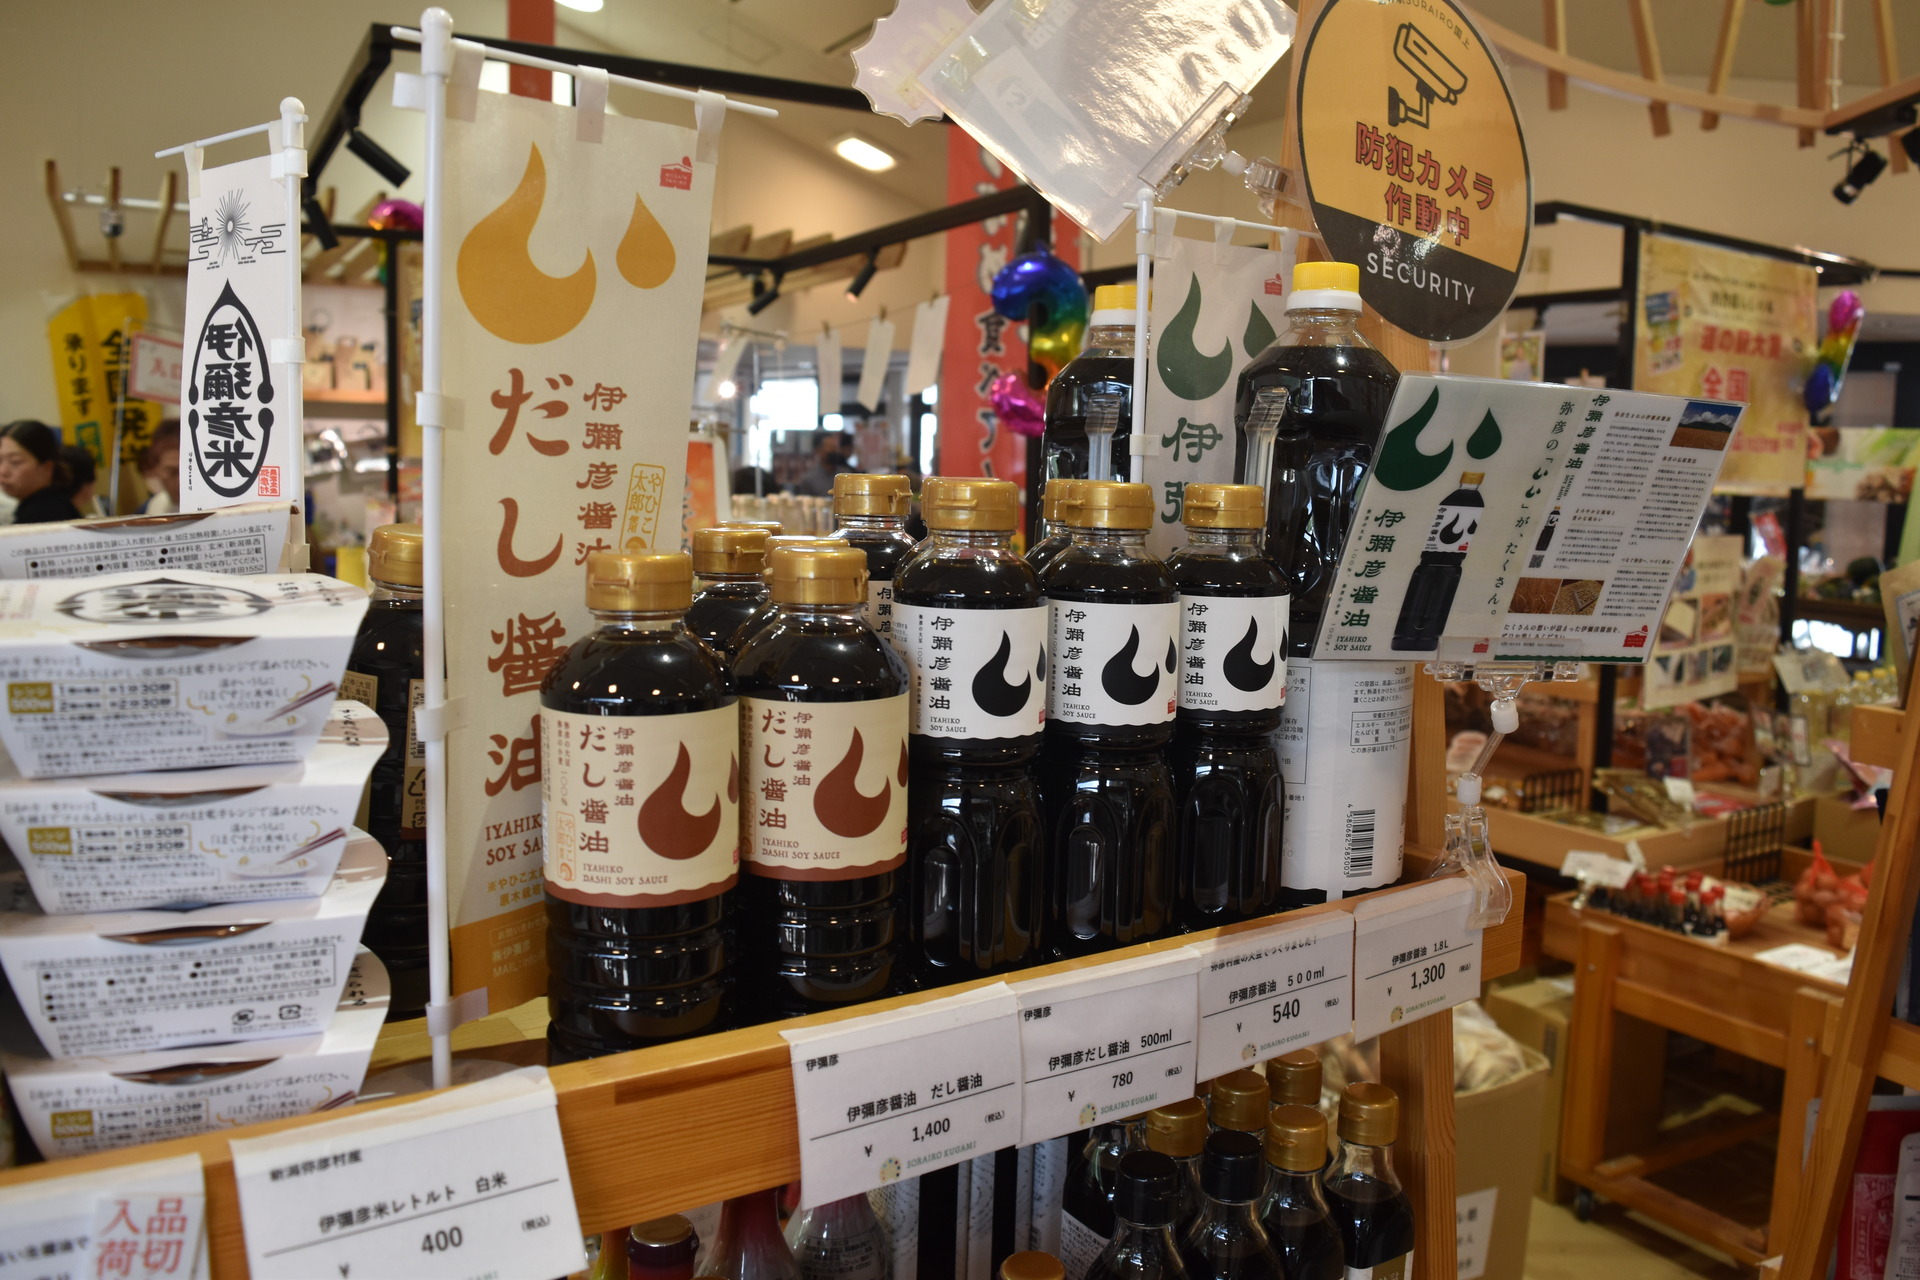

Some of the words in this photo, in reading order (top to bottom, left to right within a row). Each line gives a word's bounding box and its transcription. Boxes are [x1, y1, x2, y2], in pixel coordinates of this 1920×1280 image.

[1355, 121, 1495, 210] 防犯カメラ
[1384, 182, 1470, 246] 作動中
[1367, 251, 1475, 305] SECURITY
[1350, 644, 1372, 652] SAUCE
[1185, 690, 1213, 698] IYAHIKO
[1062, 702, 1091, 711] IYAHIKO
[1062, 710, 1075, 718] SOY
[1076, 711, 1097, 719] SAUCE
[929, 724, 943, 732] SOY
[945, 725, 967, 733] SAUCE
[930, 716, 960, 725] IYAHIKO
[759, 709, 788, 830] だし醤油
[579, 724, 610, 854] だし醤油
[485, 814, 542, 842] IYAHIK
[486, 843, 517, 866] SOY
[762, 838, 799, 848] IYAHIKO
[762, 848, 788, 858] DASHI
[792, 849, 811, 859] SOY
[813, 851, 840, 860] SAUCE
[583, 863, 624, 874] IYAHIKO
[583, 874, 612, 885] DASHI
[615, 876, 635, 885] SOY
[639, 875, 669, 885] SAUCE
[1433, 939, 1449, 952] 1.8L
[1410, 962, 1446, 990] 1,300
[1272, 998, 1301, 1024] 540
[1048, 1039, 1130, 1072] 伊彌彦だし醤油
[1140, 1029, 1173, 1048] 500ml
[1260, 1036, 1287, 1051] SORAIRO
[1286, 1030, 1310, 1044] KUGAMI
[1111, 1070, 1134, 1090] 780
[847, 1090, 918, 1124] 伊彌彦醤油
[931, 1072, 983, 1100] だし醤油
[1100, 1099, 1128, 1115] SORAIRO
[1129, 1092, 1158, 1109] KUGAMI
[911, 1118, 951, 1144] 1,400
[906, 1148, 942, 1169] SORAIRO
[942, 1140, 977, 1161] KUGAMI
[475, 1171, 508, 1193] 白米
[420, 1226, 463, 1255] 400
